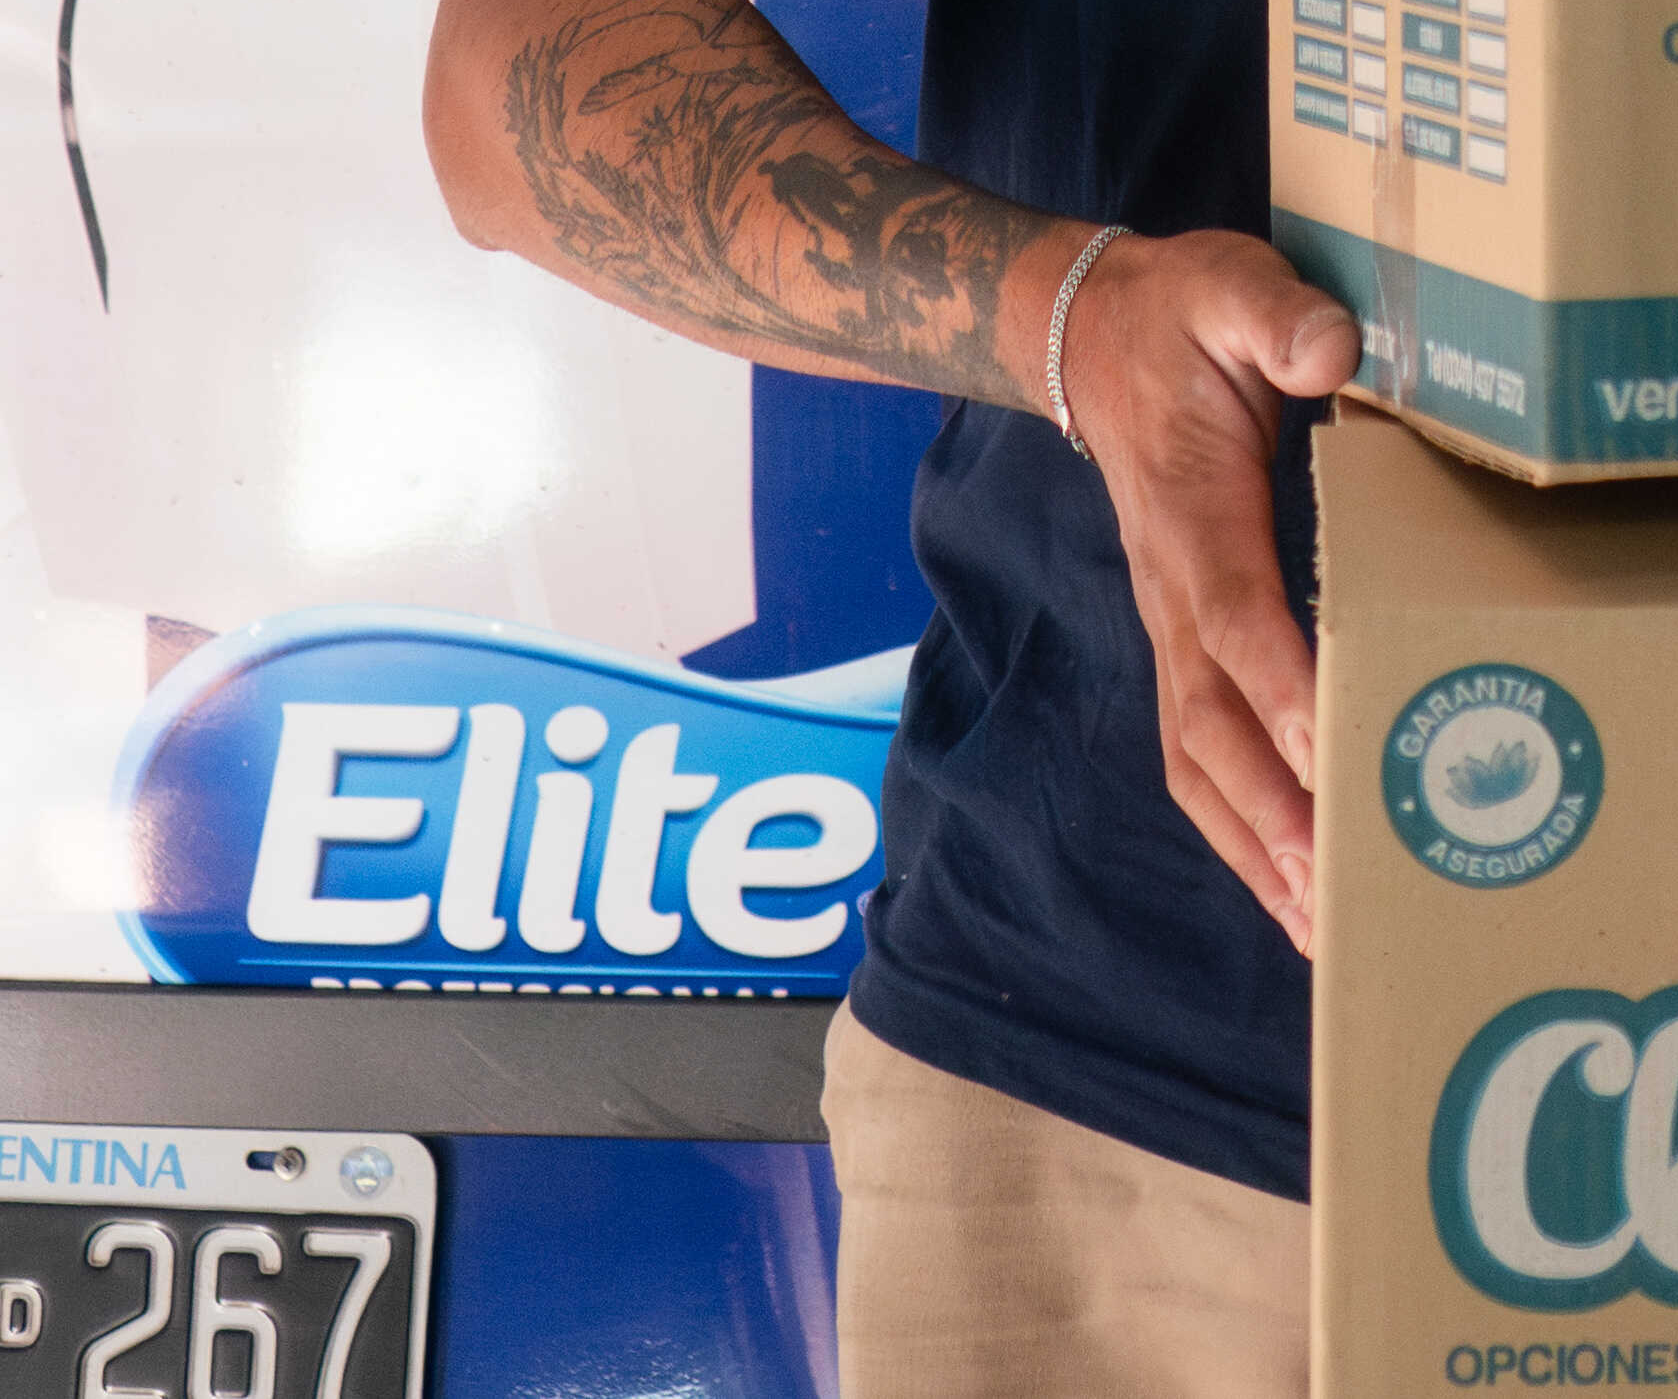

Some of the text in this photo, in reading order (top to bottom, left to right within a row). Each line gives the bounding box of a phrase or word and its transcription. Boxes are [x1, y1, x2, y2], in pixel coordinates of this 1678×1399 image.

[1397, 676, 1546, 758] GARANTIA
[247, 703, 878, 959] Elite
[1426, 795, 1585, 879] ASEGURADA
[78, 1219, 392, 1399] 267
